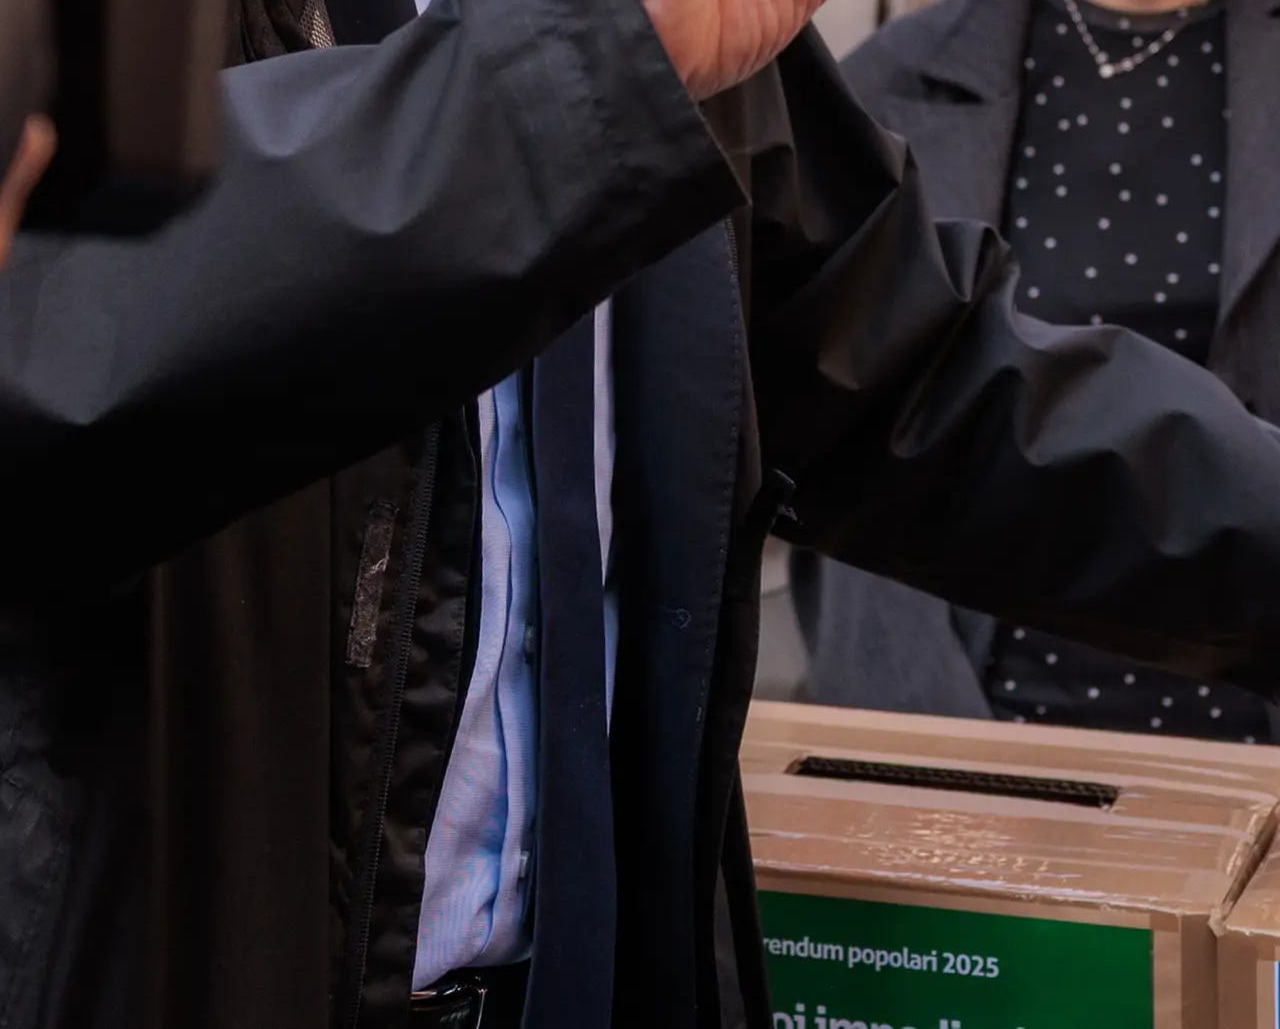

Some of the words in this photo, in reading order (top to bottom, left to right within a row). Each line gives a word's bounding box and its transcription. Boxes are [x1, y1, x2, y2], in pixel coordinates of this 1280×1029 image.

[763, 936, 844, 961] rendum
[847, 947, 939, 972] popolari
[942, 952, 1000, 978] 2025
